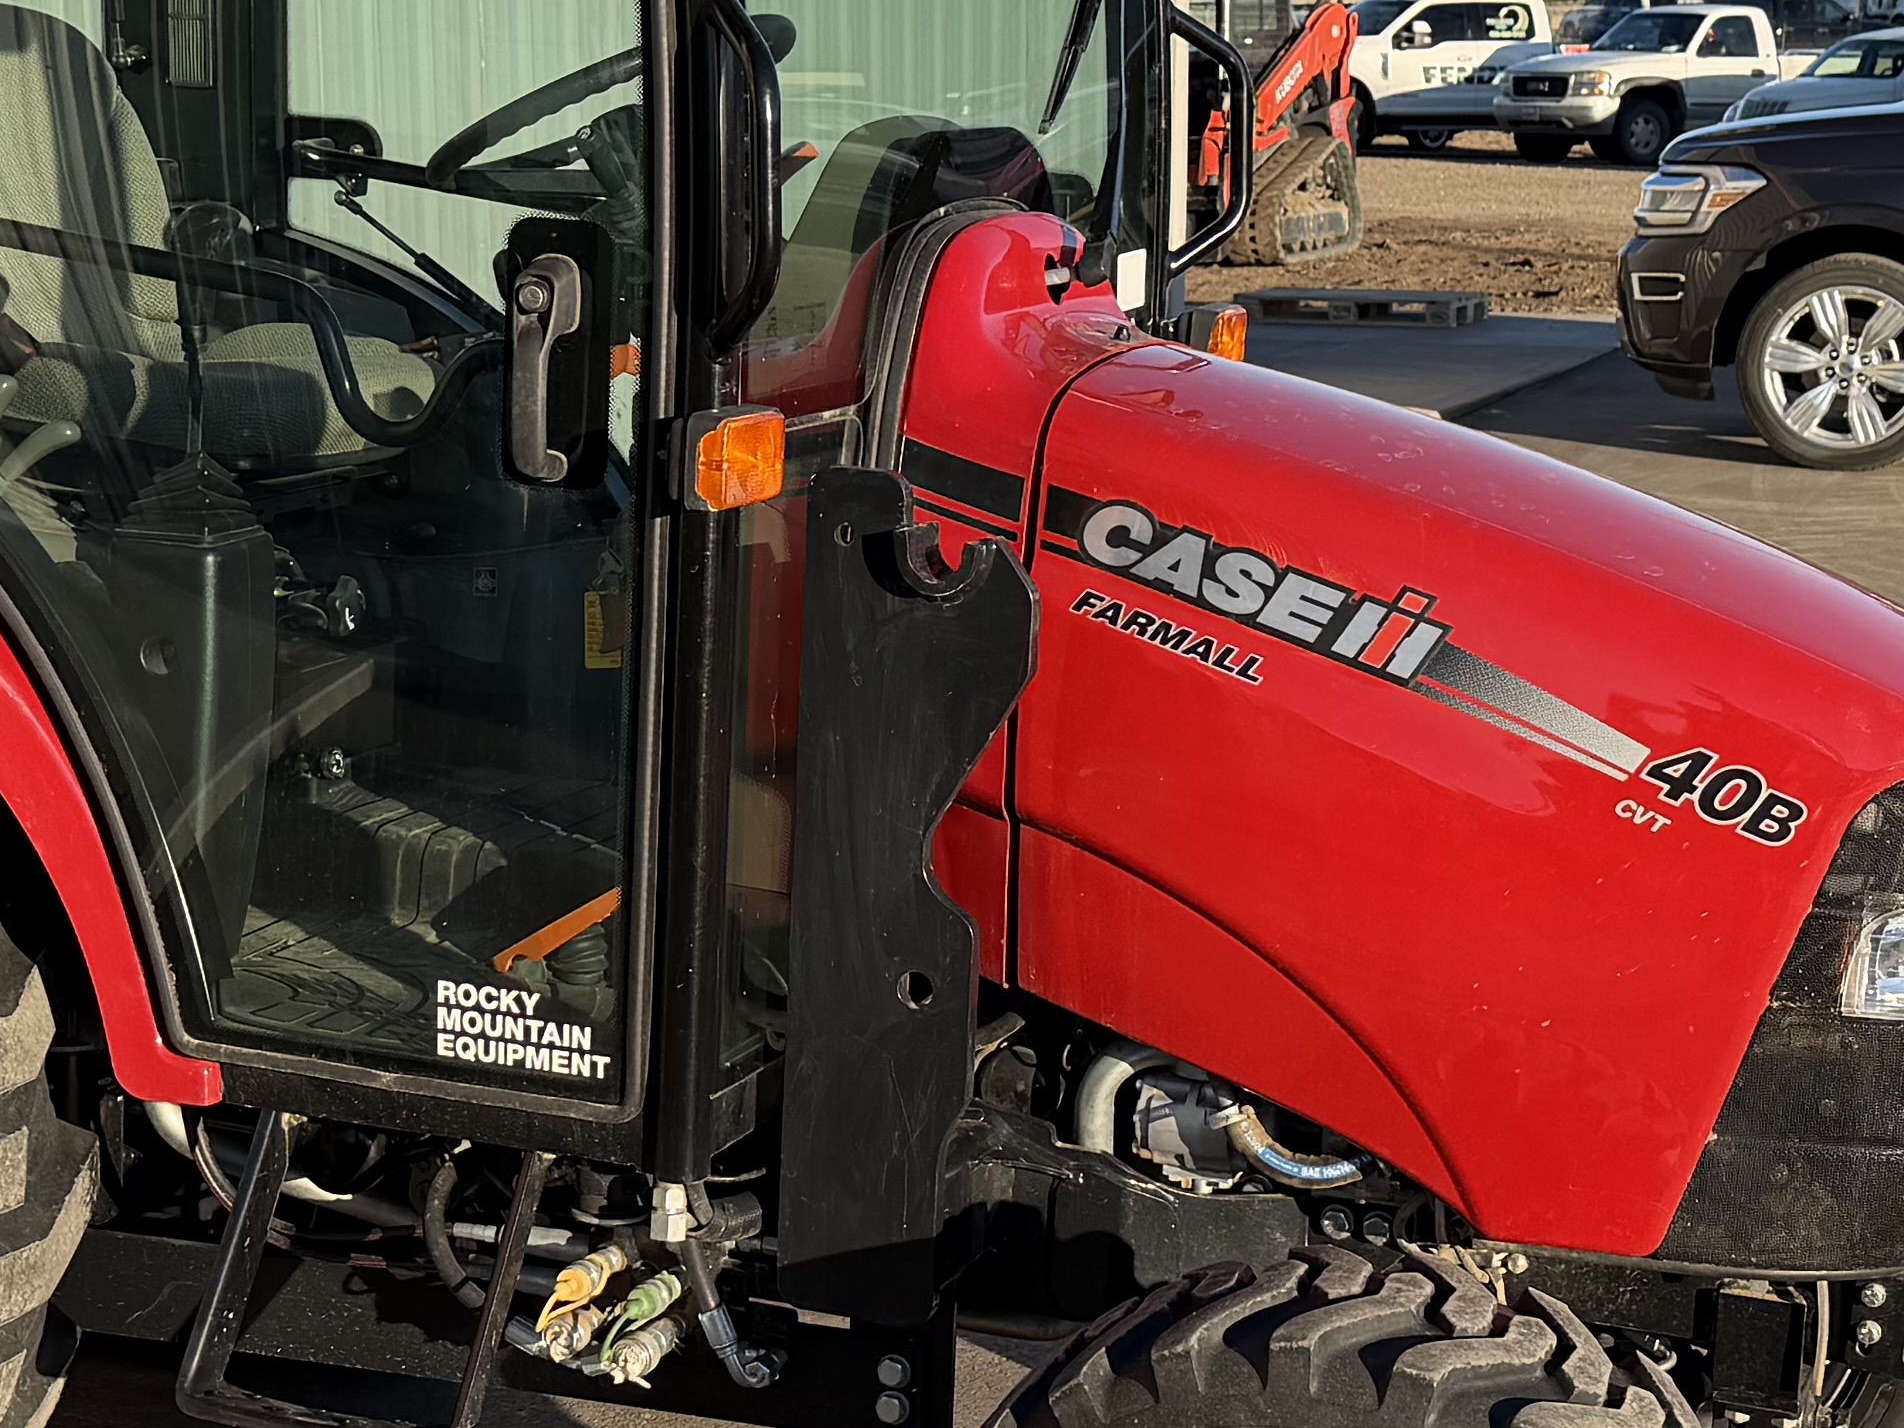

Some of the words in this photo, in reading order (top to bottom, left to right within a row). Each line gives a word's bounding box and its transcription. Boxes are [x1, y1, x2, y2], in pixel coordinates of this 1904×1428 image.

[1083, 504, 1348, 644] CASE
[1070, 589, 1264, 685] FARMALL
[1615, 799, 1672, 833] CVT
[1639, 747, 1808, 847] 40B
[437, 979, 541, 1016] ROCKY
[437, 1006, 592, 1050] MOUNTAIN
[437, 1033, 611, 1079] EQUIPMENT
